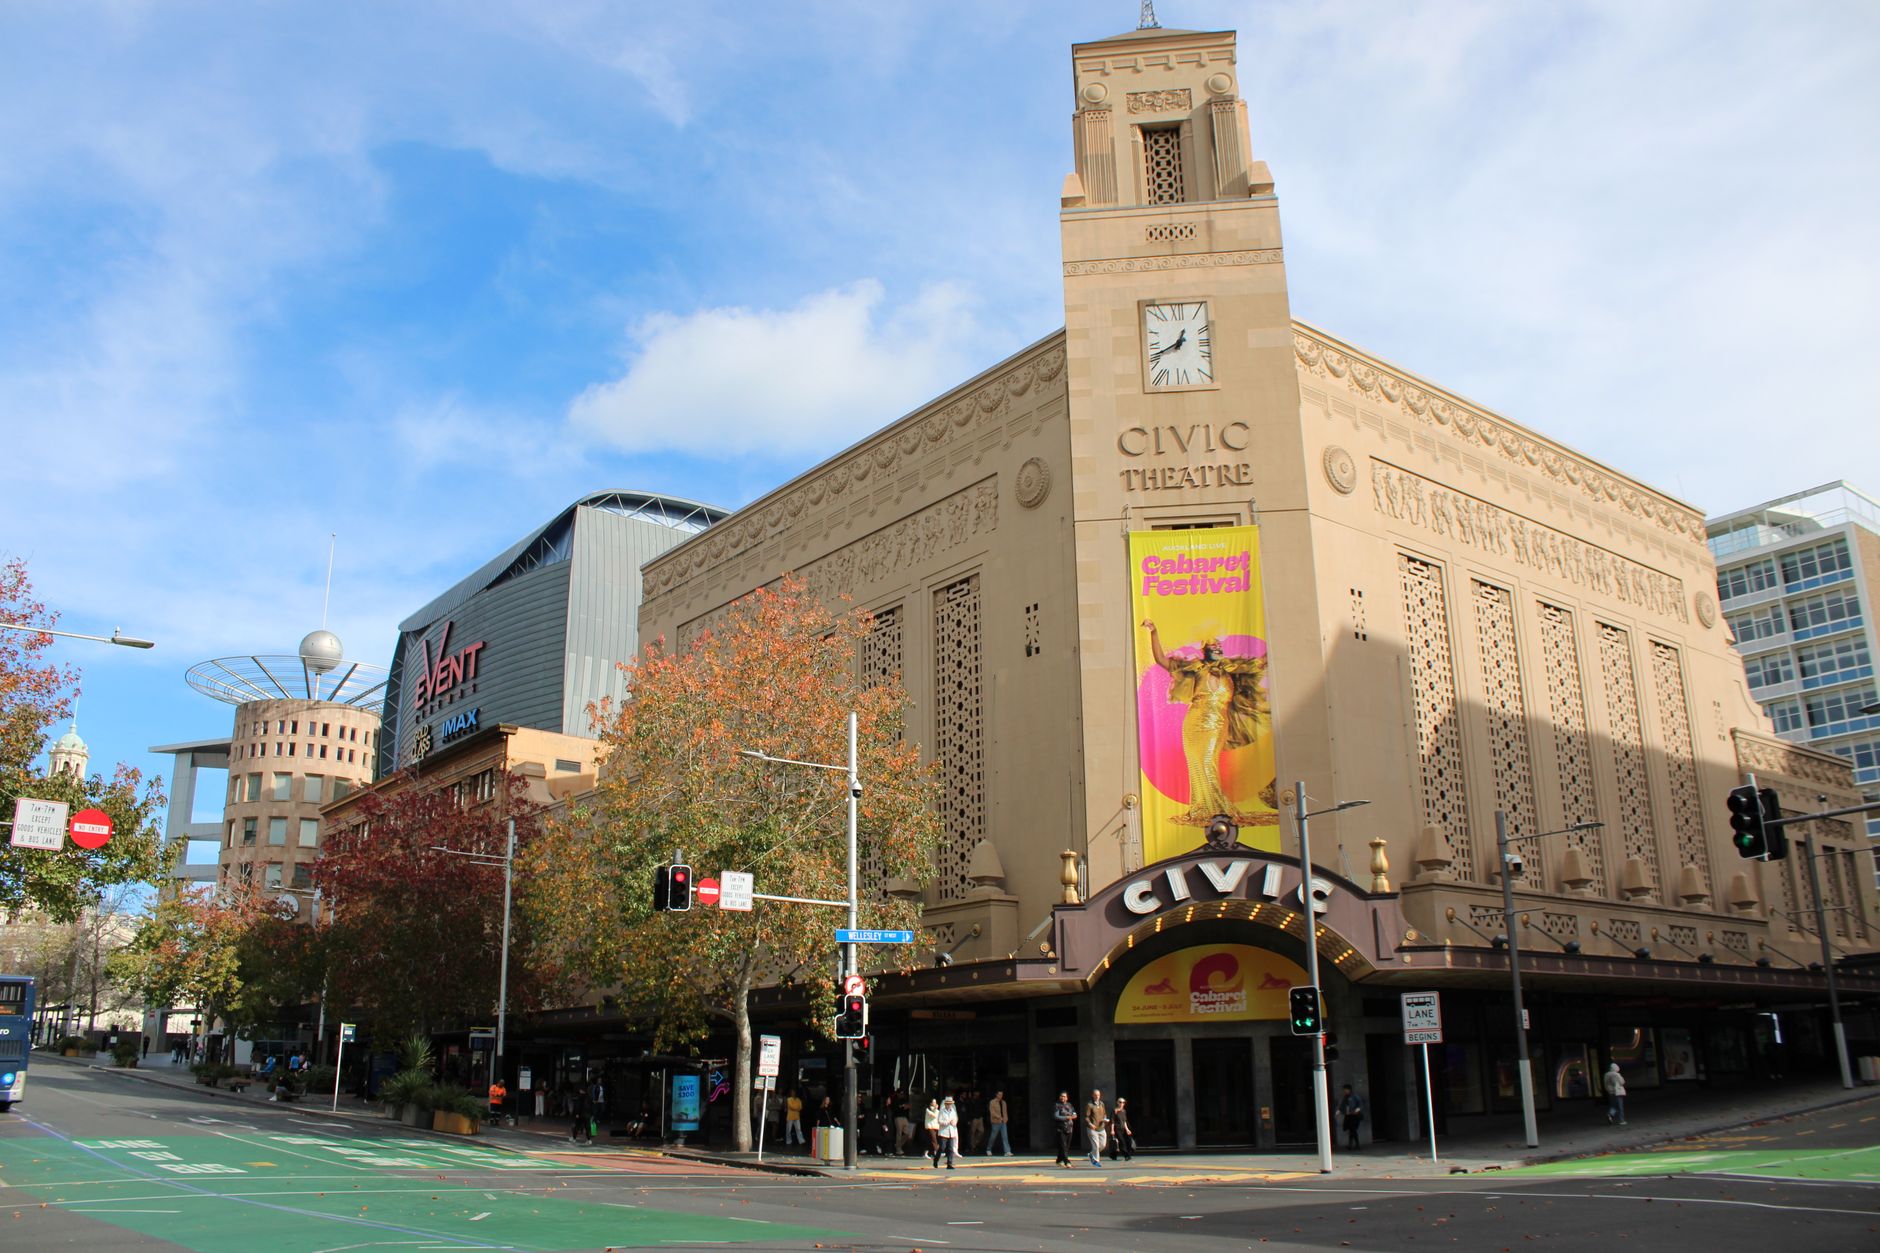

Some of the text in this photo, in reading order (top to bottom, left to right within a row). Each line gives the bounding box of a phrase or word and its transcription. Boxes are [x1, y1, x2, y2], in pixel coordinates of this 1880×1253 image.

[1117, 421, 1250, 457] CIVIC
[1119, 463, 1254, 492] THEATRE
[1141, 550, 1250, 575] Cabaret
[1142, 570, 1251, 597] Festival
[415, 621, 485, 709] EVENT
[442, 708, 479, 738] IMAX
[31, 815, 52, 824] EXCEPT
[37, 825, 62, 836] VEHICLES
[42, 836, 56, 845] LANE
[1124, 860, 1335, 914] CIVIC
[848, 931, 882, 940] WELLESLEY
[1190, 990, 1247, 1003] Cabaret
[1190, 1002, 1247, 1014] Festival
[1408, 1009, 1434, 1019] LANE
[1408, 1032, 1438, 1041] BEGINS
[155, 1163, 248, 1174] BUS
